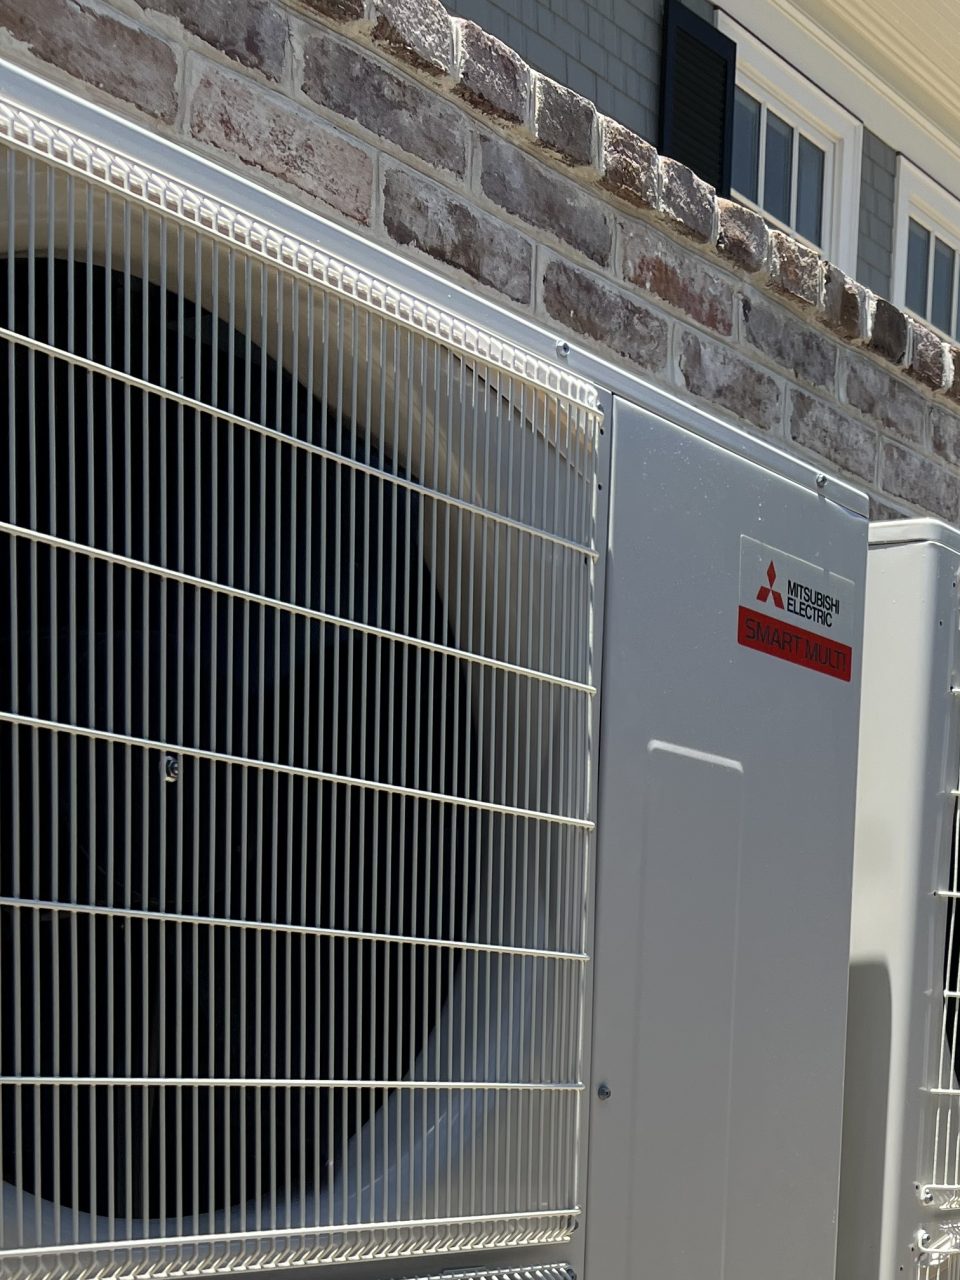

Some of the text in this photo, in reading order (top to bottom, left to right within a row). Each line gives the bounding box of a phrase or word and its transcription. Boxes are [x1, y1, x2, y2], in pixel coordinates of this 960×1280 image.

[787, 579, 840, 615] MITSUBISHI
[787, 600, 833, 628] ELECTRIC
[745, 618, 847, 672] SMART MULTI
